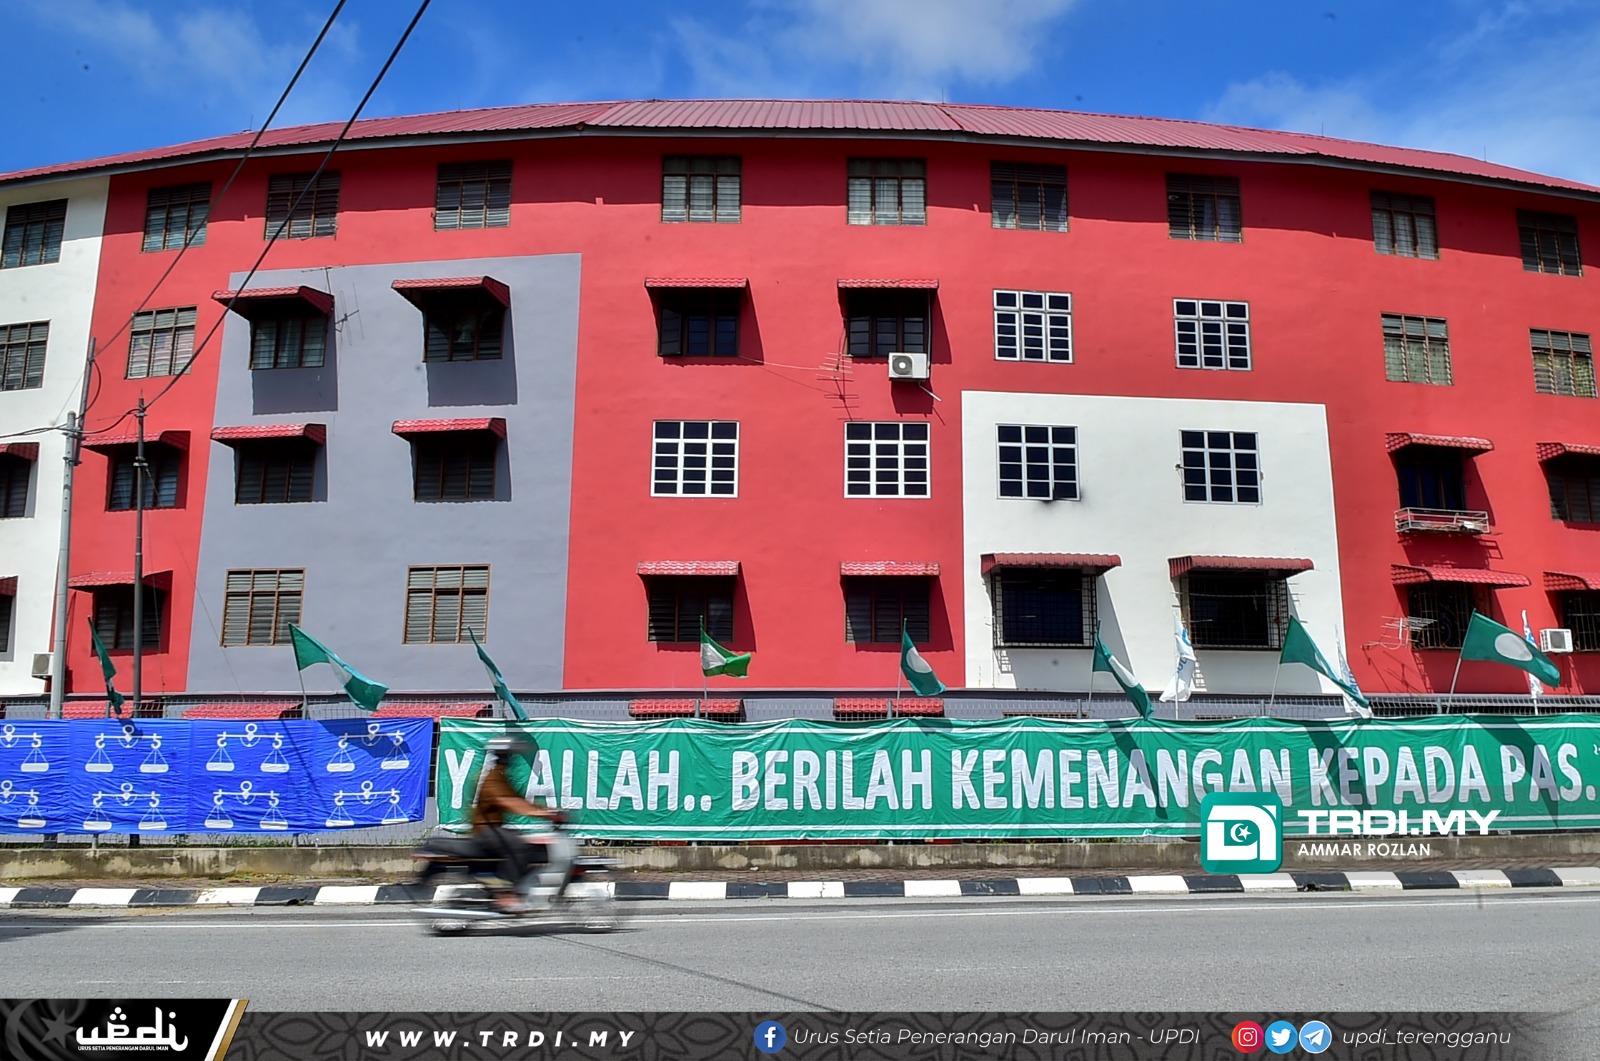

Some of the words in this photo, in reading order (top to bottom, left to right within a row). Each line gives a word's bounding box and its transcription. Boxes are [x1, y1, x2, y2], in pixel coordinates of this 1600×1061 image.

[525, 749, 712, 811] ALLAH..
[731, 749, 933, 811] BERILAH
[951, 748, 1293, 810] KEMENANGAN
[1308, 744, 1492, 807] KEPADA
[1499, 742, 1597, 803] PAS.
